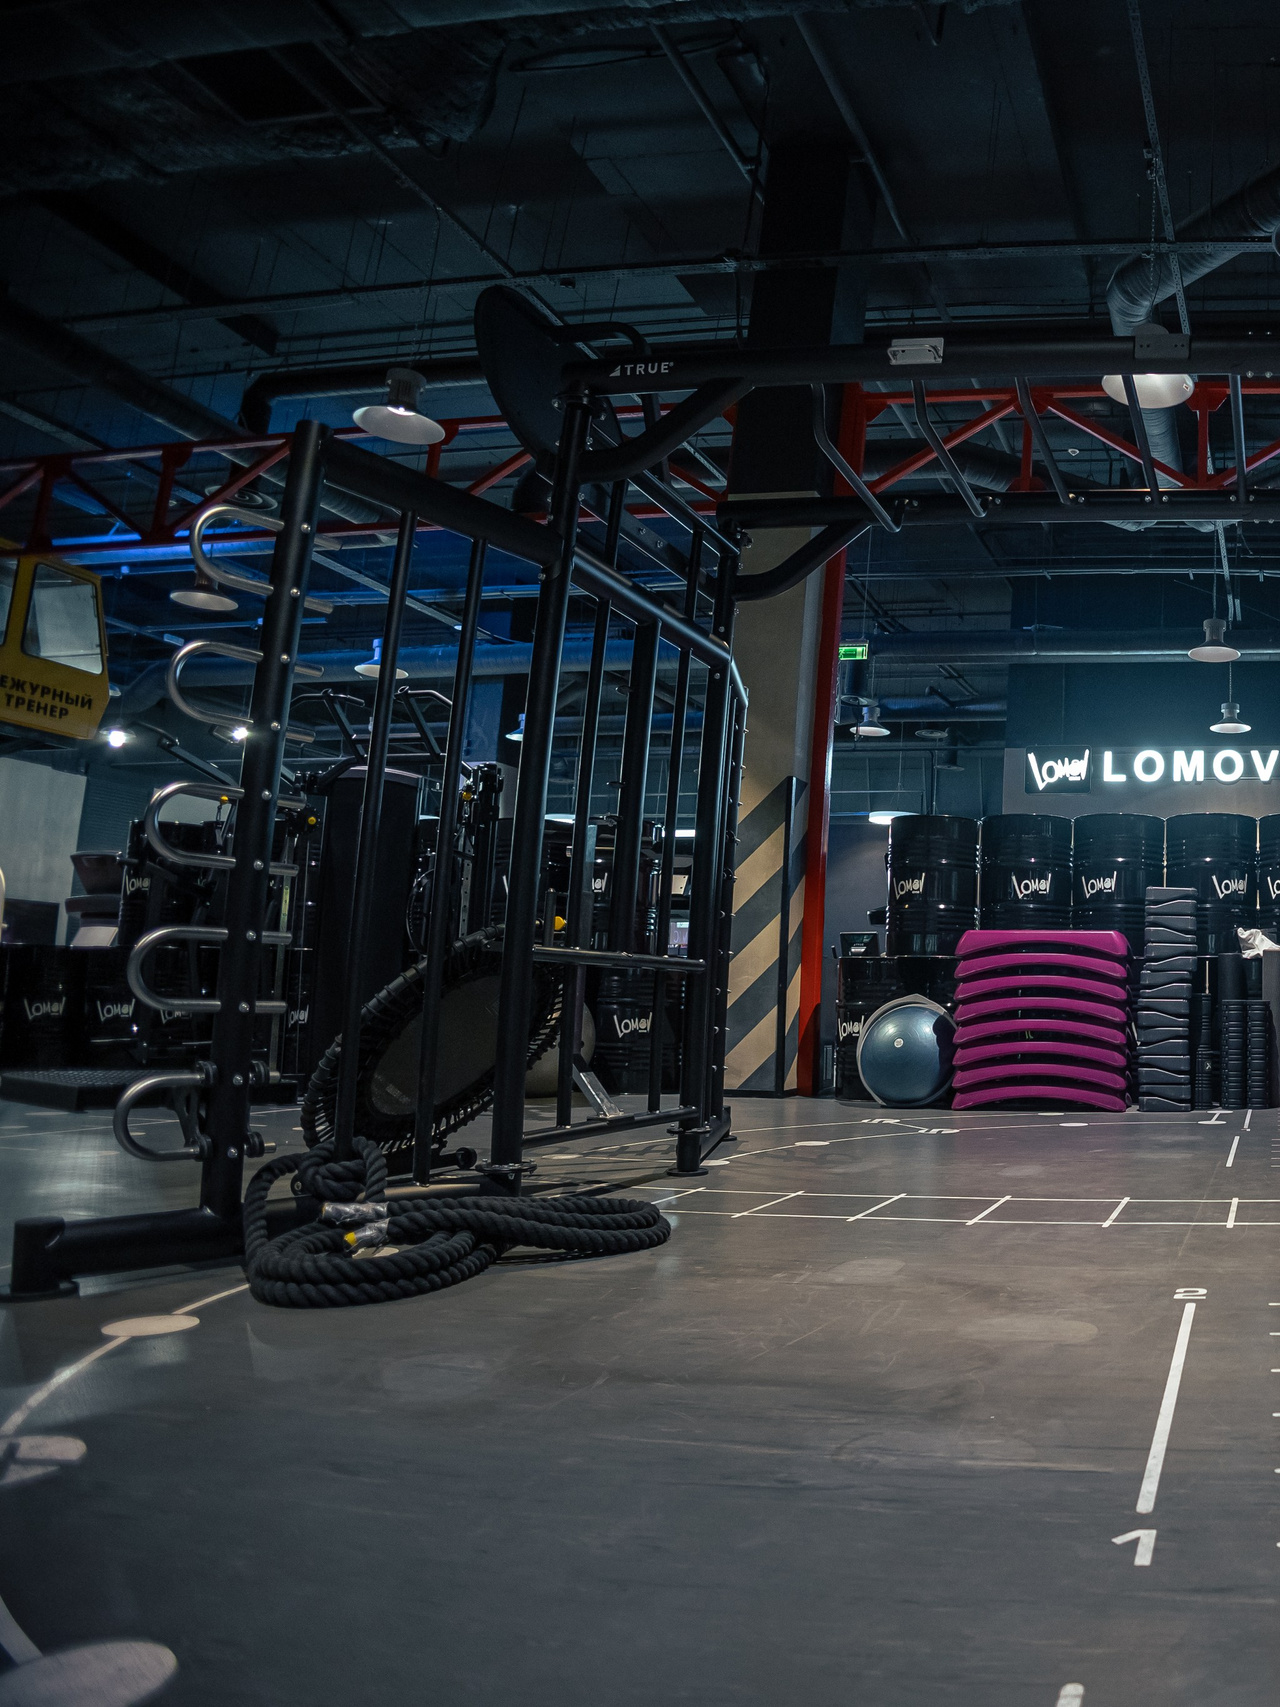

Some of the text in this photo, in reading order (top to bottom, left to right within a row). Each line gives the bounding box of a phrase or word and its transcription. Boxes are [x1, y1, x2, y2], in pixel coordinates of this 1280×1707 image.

[625, 362, 669, 376] TRUE
[5, 693, 69, 719] ТРЕНЕР
[1103, 750, 1280, 783] LOMOV
[1173, 1287, 1208, 1300] 2
[1111, 1529, 1157, 1567] 1
